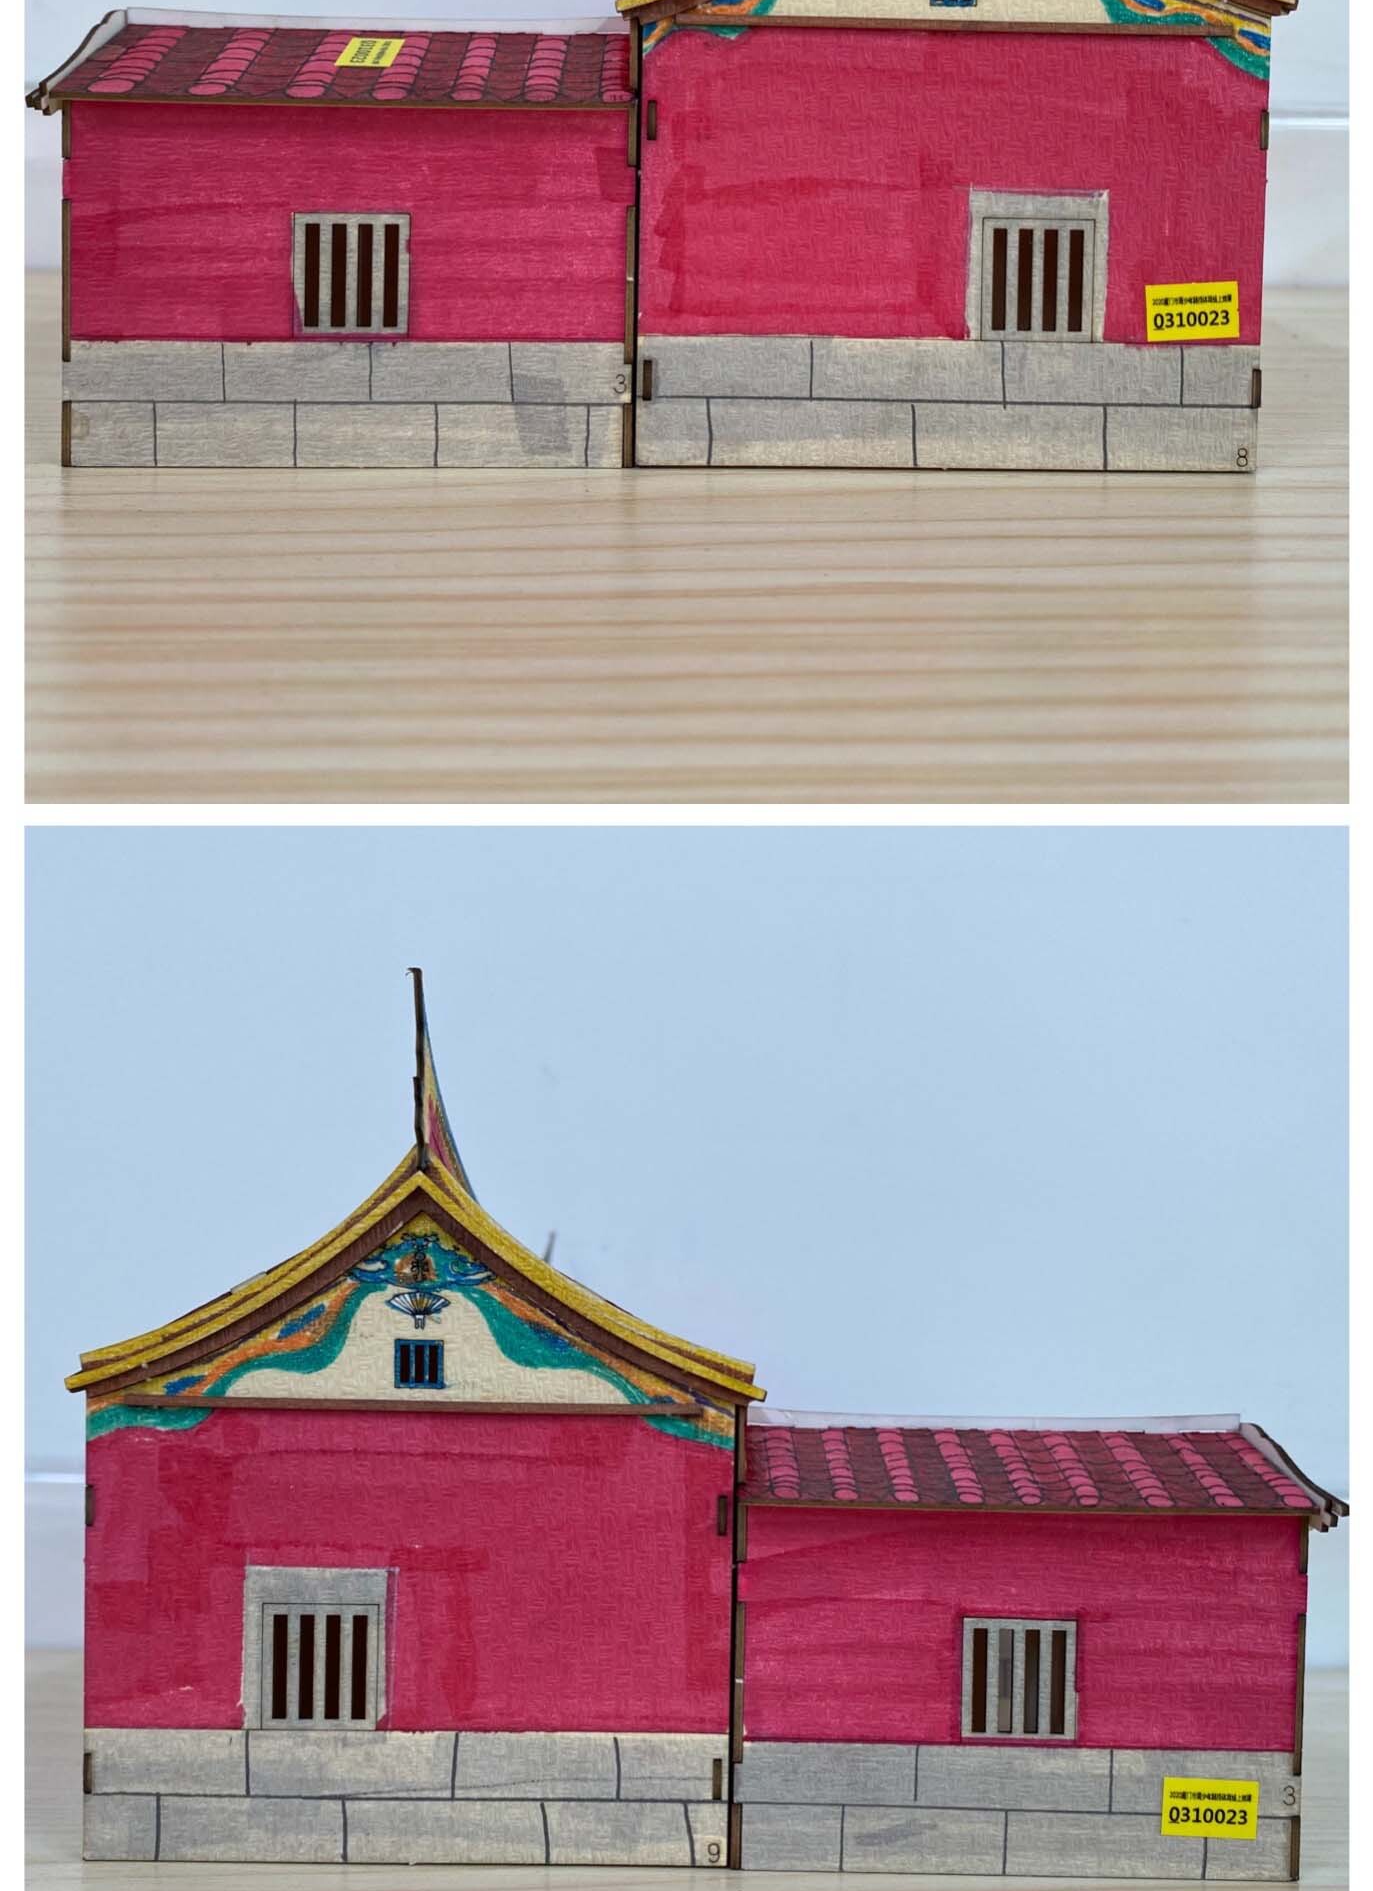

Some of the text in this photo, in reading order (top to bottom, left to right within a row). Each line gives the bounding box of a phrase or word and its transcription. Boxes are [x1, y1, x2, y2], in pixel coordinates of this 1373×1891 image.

[1153, 309, 1231, 331] 0310023
[613, 373, 627, 394] 3
[1236, 447, 1248, 468] 8
[1282, 1785, 1297, 1807] 3
[1168, 1805, 1248, 1826] 0310023
[707, 1842, 721, 1864] 9
